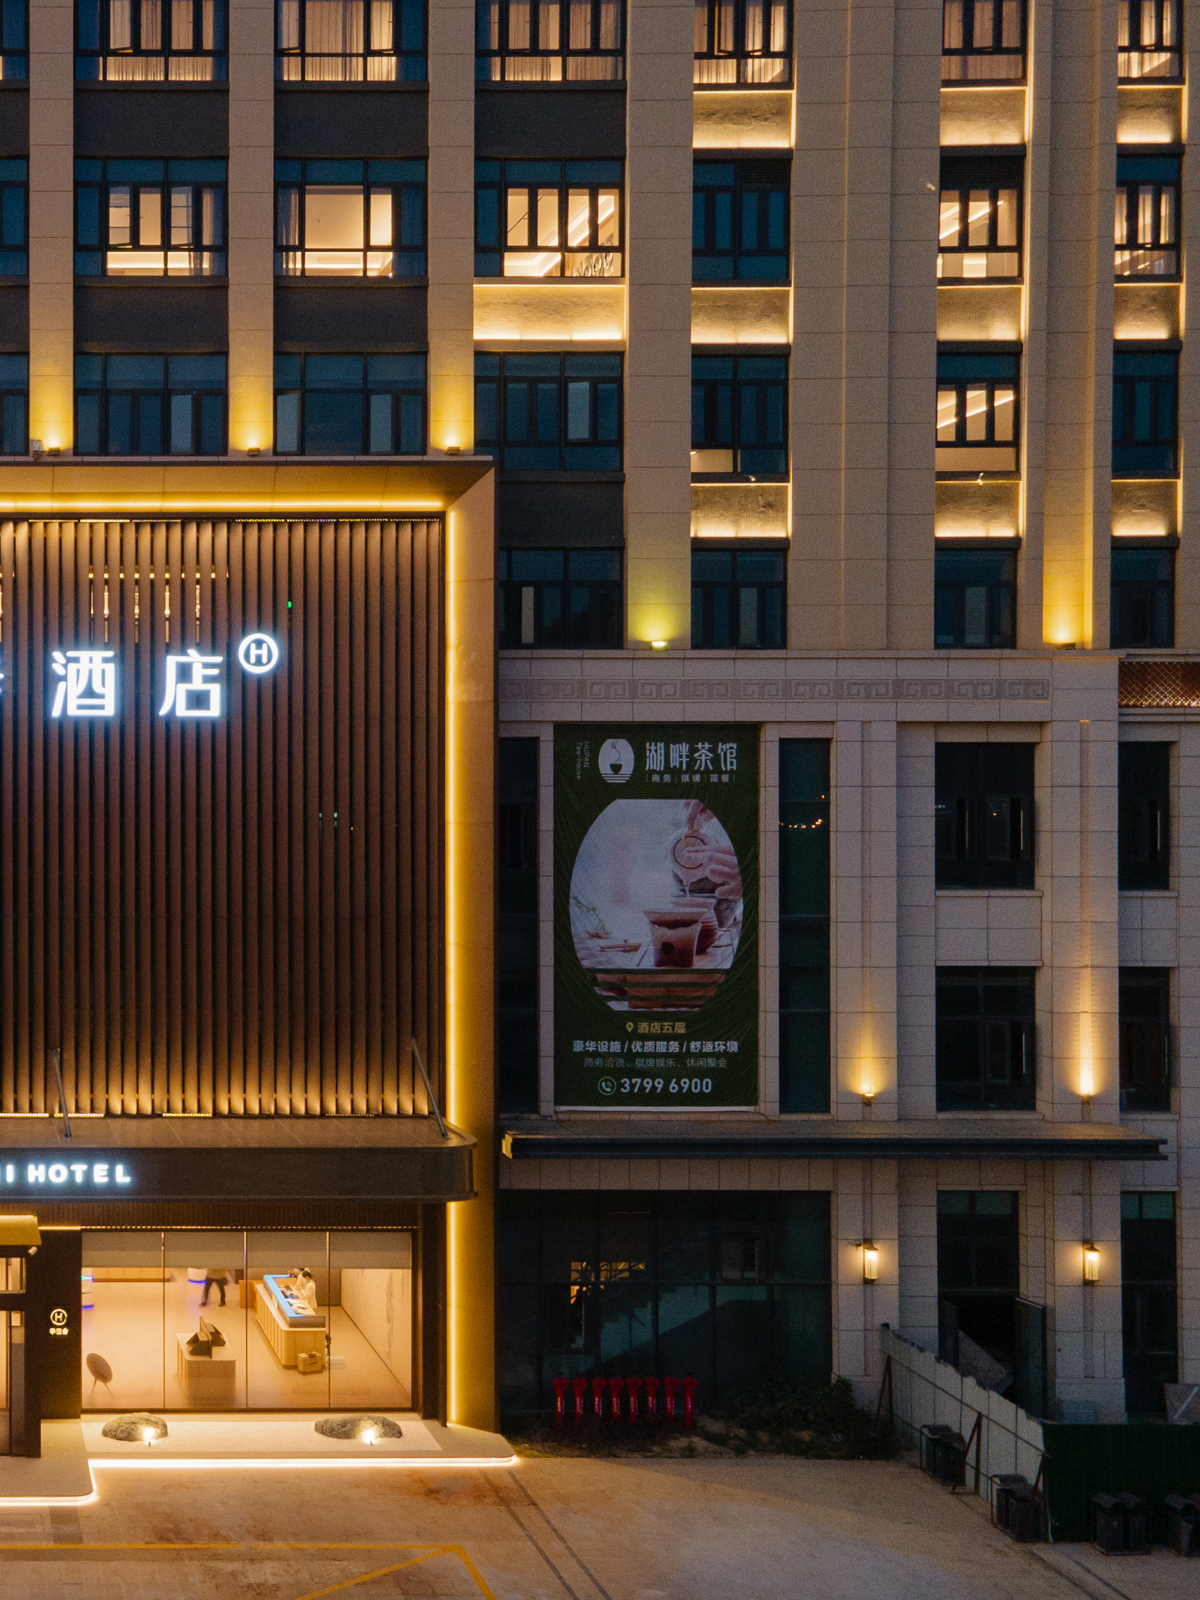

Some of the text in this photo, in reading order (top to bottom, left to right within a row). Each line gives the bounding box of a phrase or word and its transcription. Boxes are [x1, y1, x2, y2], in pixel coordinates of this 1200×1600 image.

[645, 742, 738, 772] 湖畔茶馆
[637, 1021, 687, 1034] 酒店五层
[620, 1078, 712, 1093] 3799 6900
[27, 1164, 131, 1183] HOTEL
